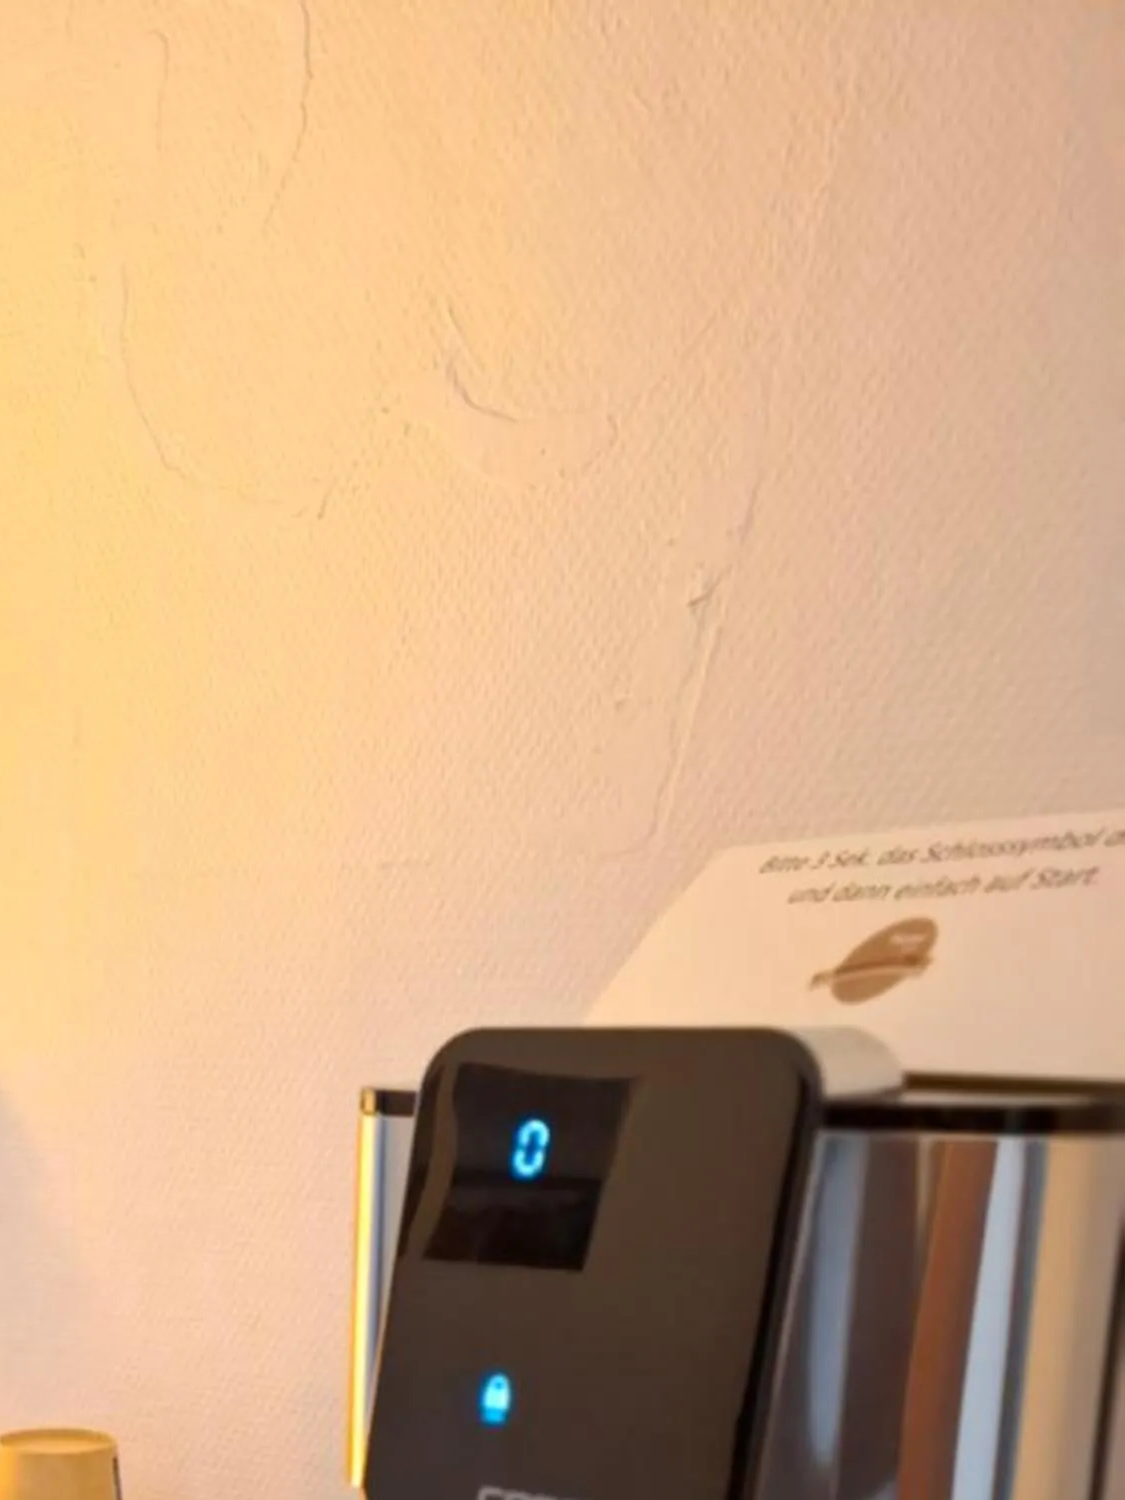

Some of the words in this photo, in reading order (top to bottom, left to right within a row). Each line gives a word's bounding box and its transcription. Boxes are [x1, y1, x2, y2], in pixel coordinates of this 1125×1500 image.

[787, 881, 837, 905] und
[984, 866, 1038, 894] auf
[513, 1118, 550, 1178] 0
